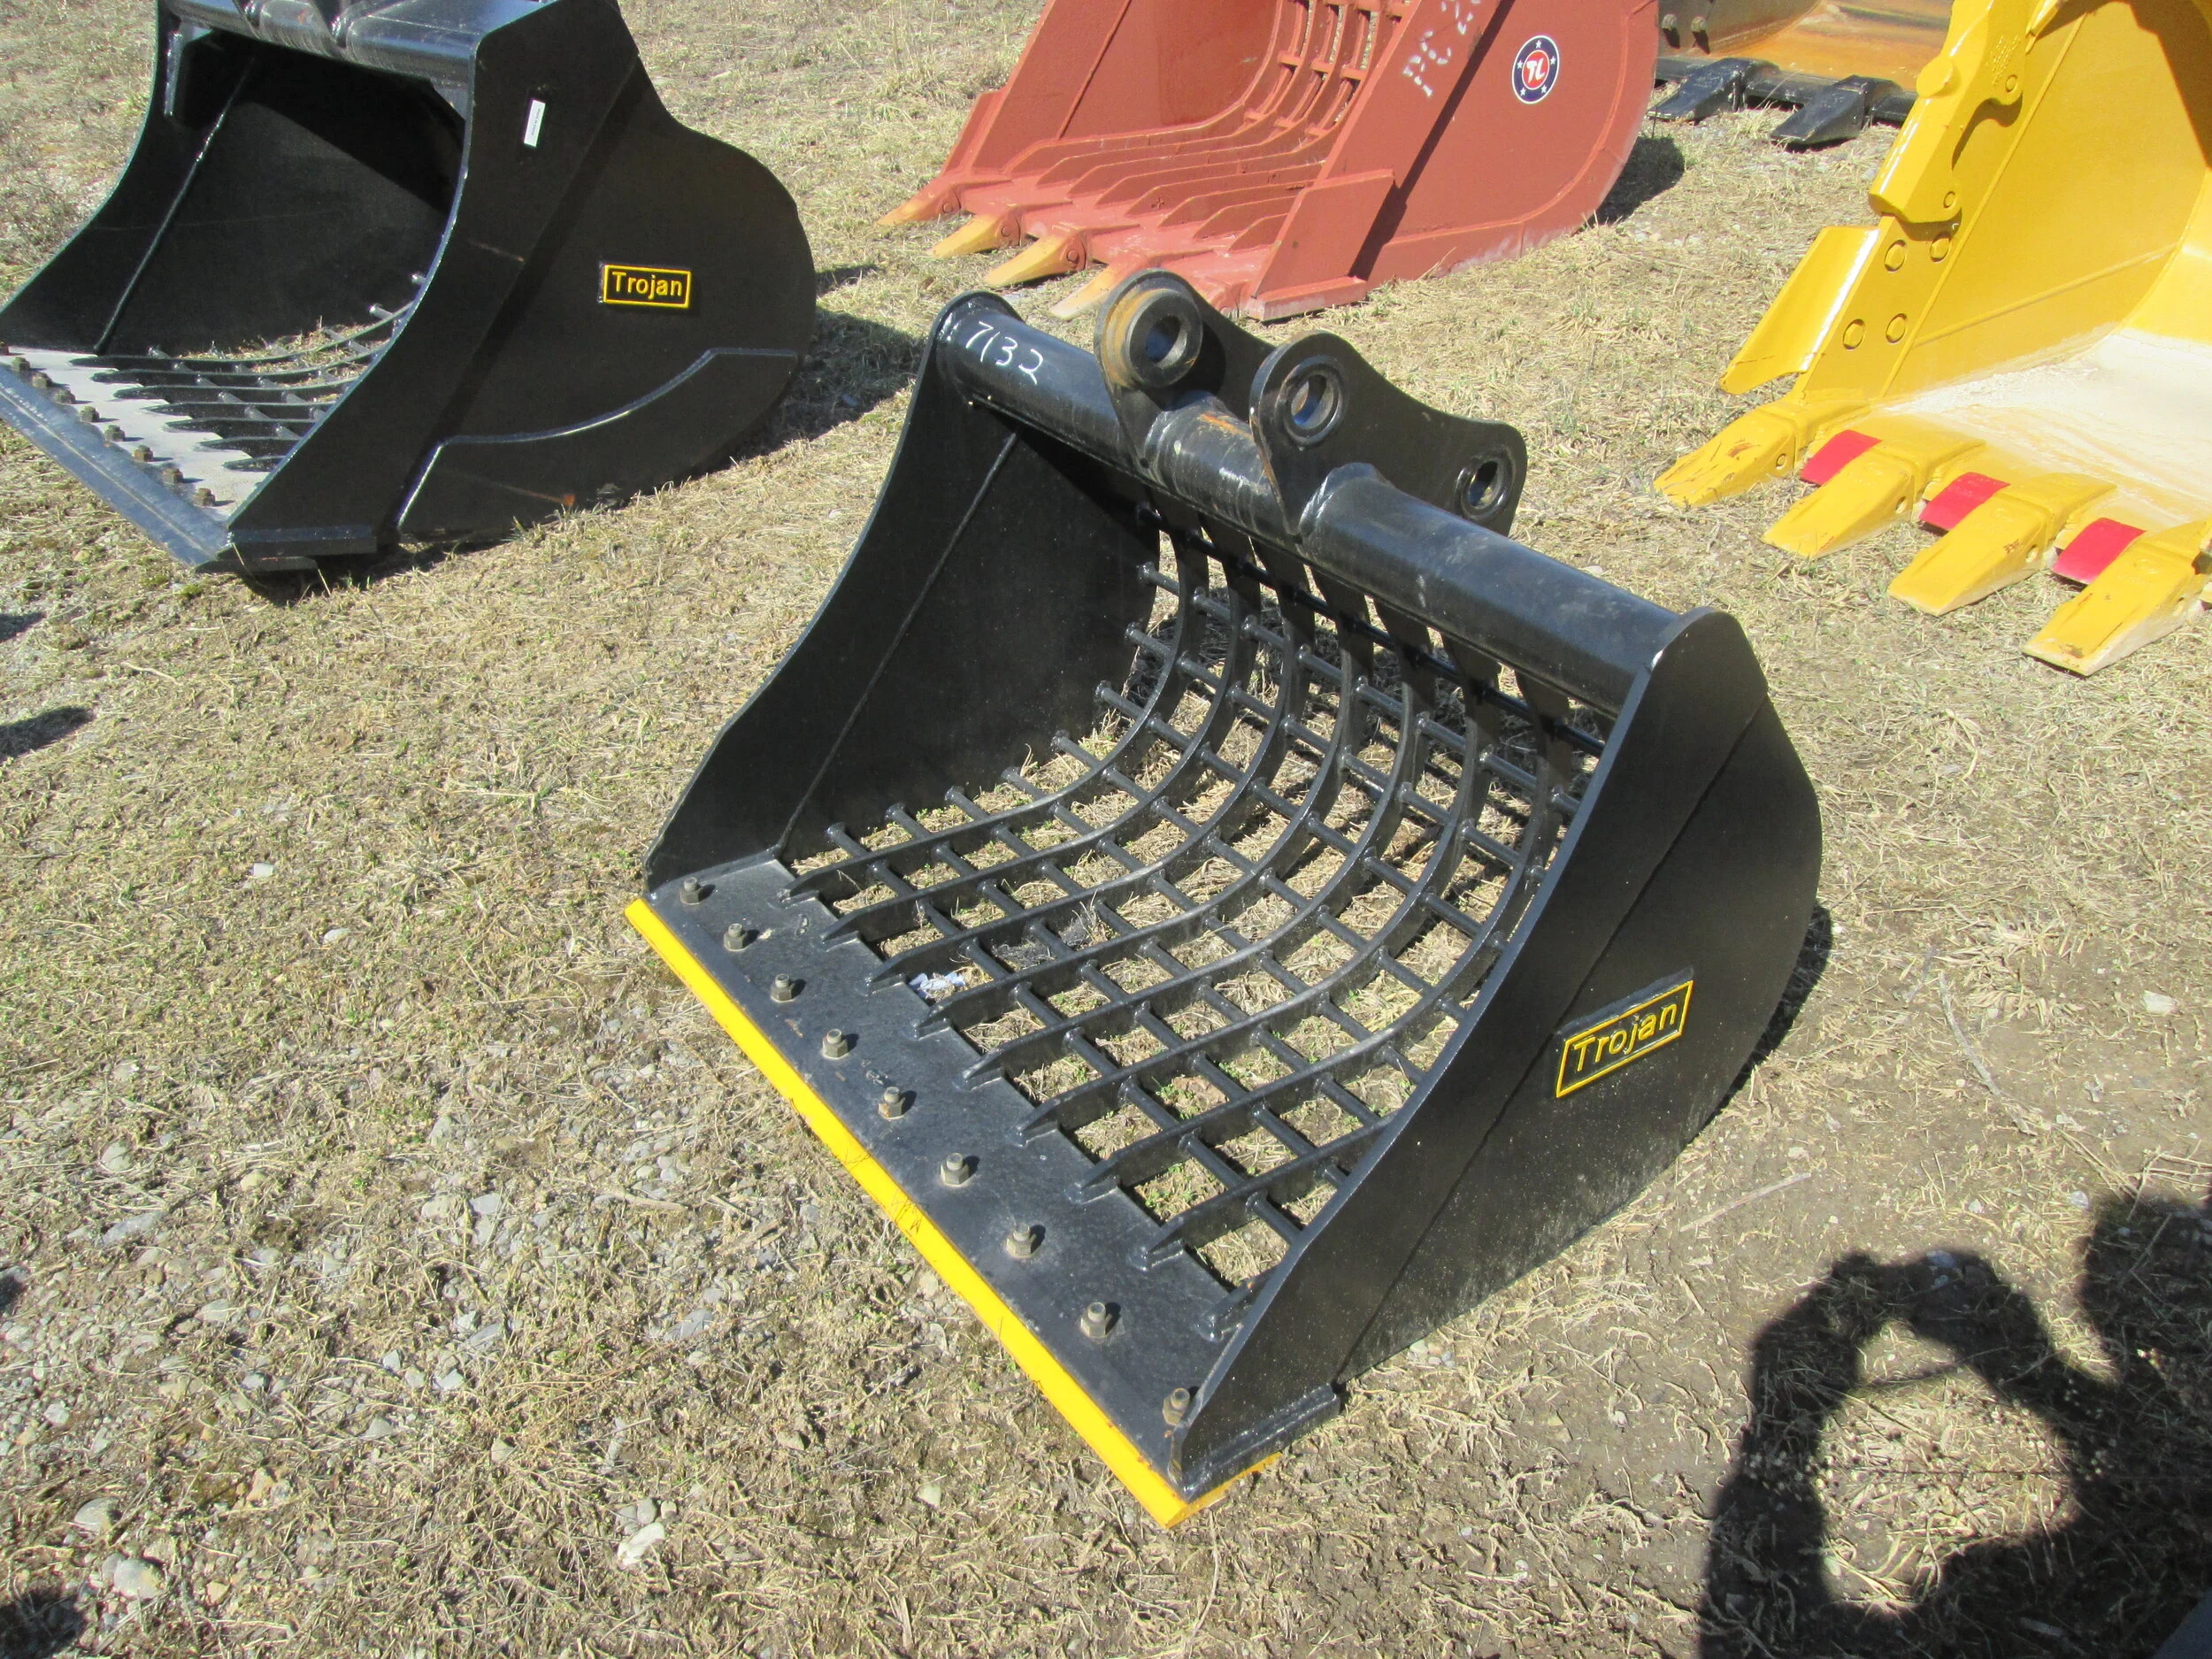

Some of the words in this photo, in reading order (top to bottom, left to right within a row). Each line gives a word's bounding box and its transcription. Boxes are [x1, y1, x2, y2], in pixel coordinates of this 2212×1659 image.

[611, 271, 683, 300] Trojan
[965, 320, 1044, 386] 7132
[1573, 1003, 1678, 1072] Trojan
